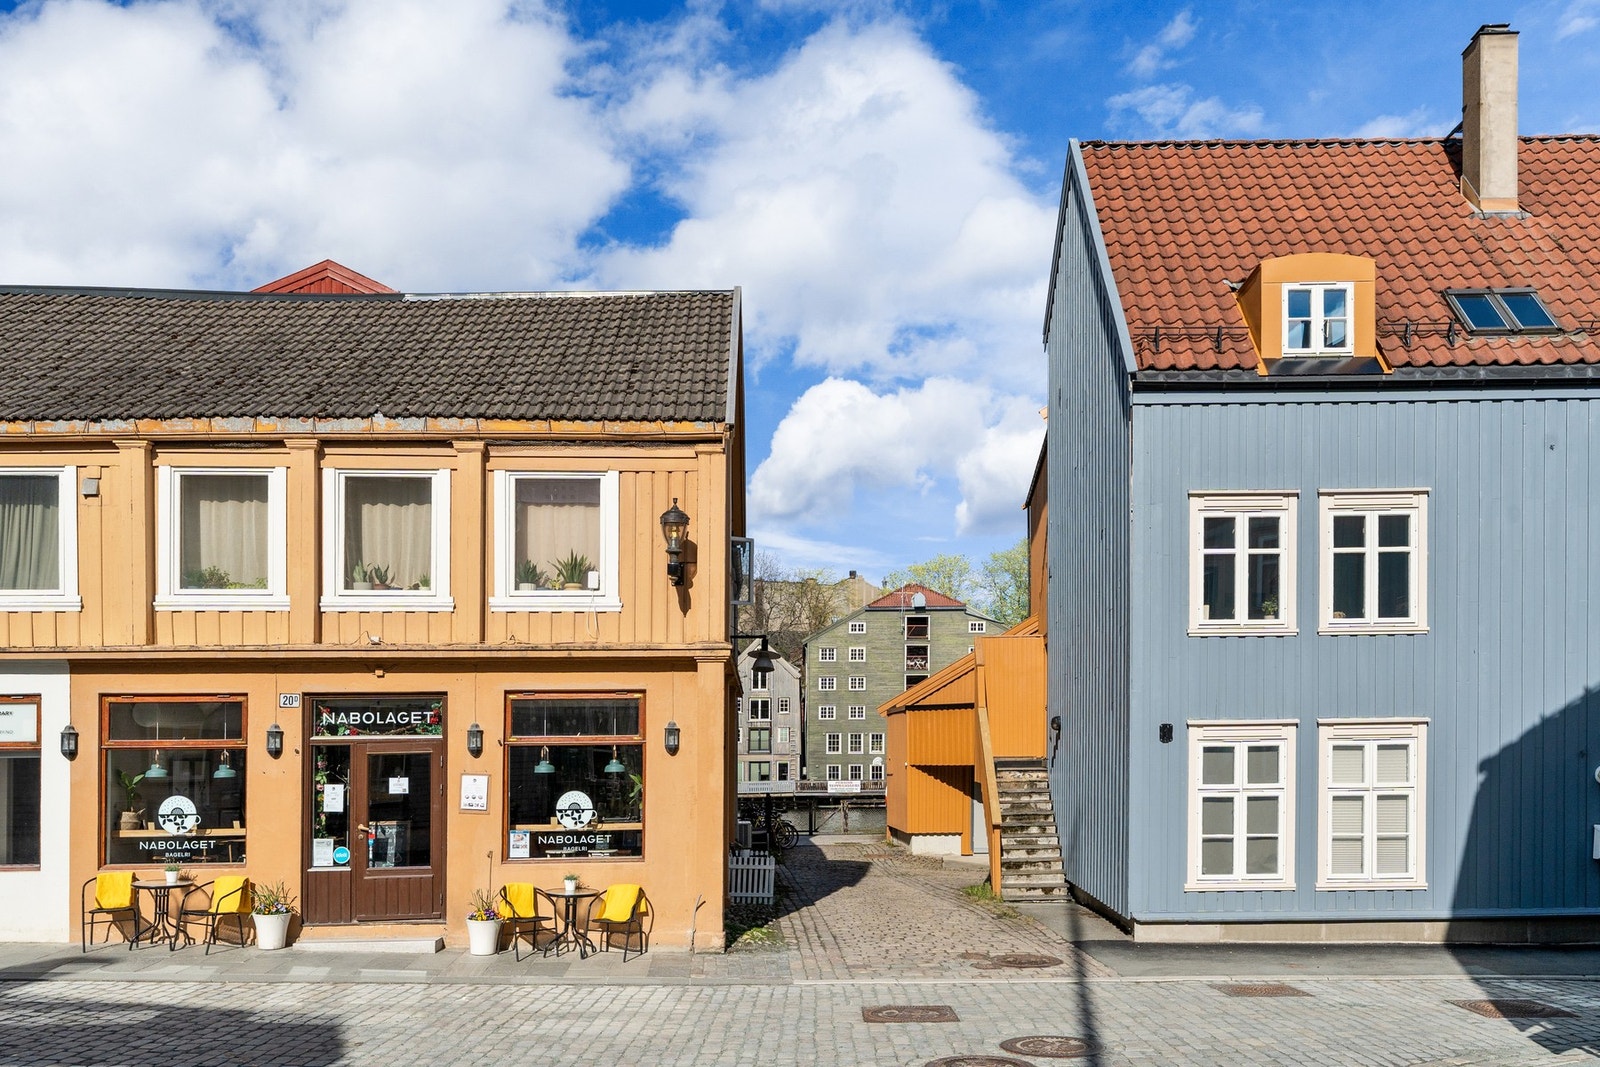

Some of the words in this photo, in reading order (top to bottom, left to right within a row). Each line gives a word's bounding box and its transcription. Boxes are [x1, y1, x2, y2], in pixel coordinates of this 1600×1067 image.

[283, 695, 298, 706] 20D
[322, 711, 435, 725] NABOLAGET
[139, 840, 216, 850] NABOLAGET
[538, 834, 612, 845] NABOLAGET
